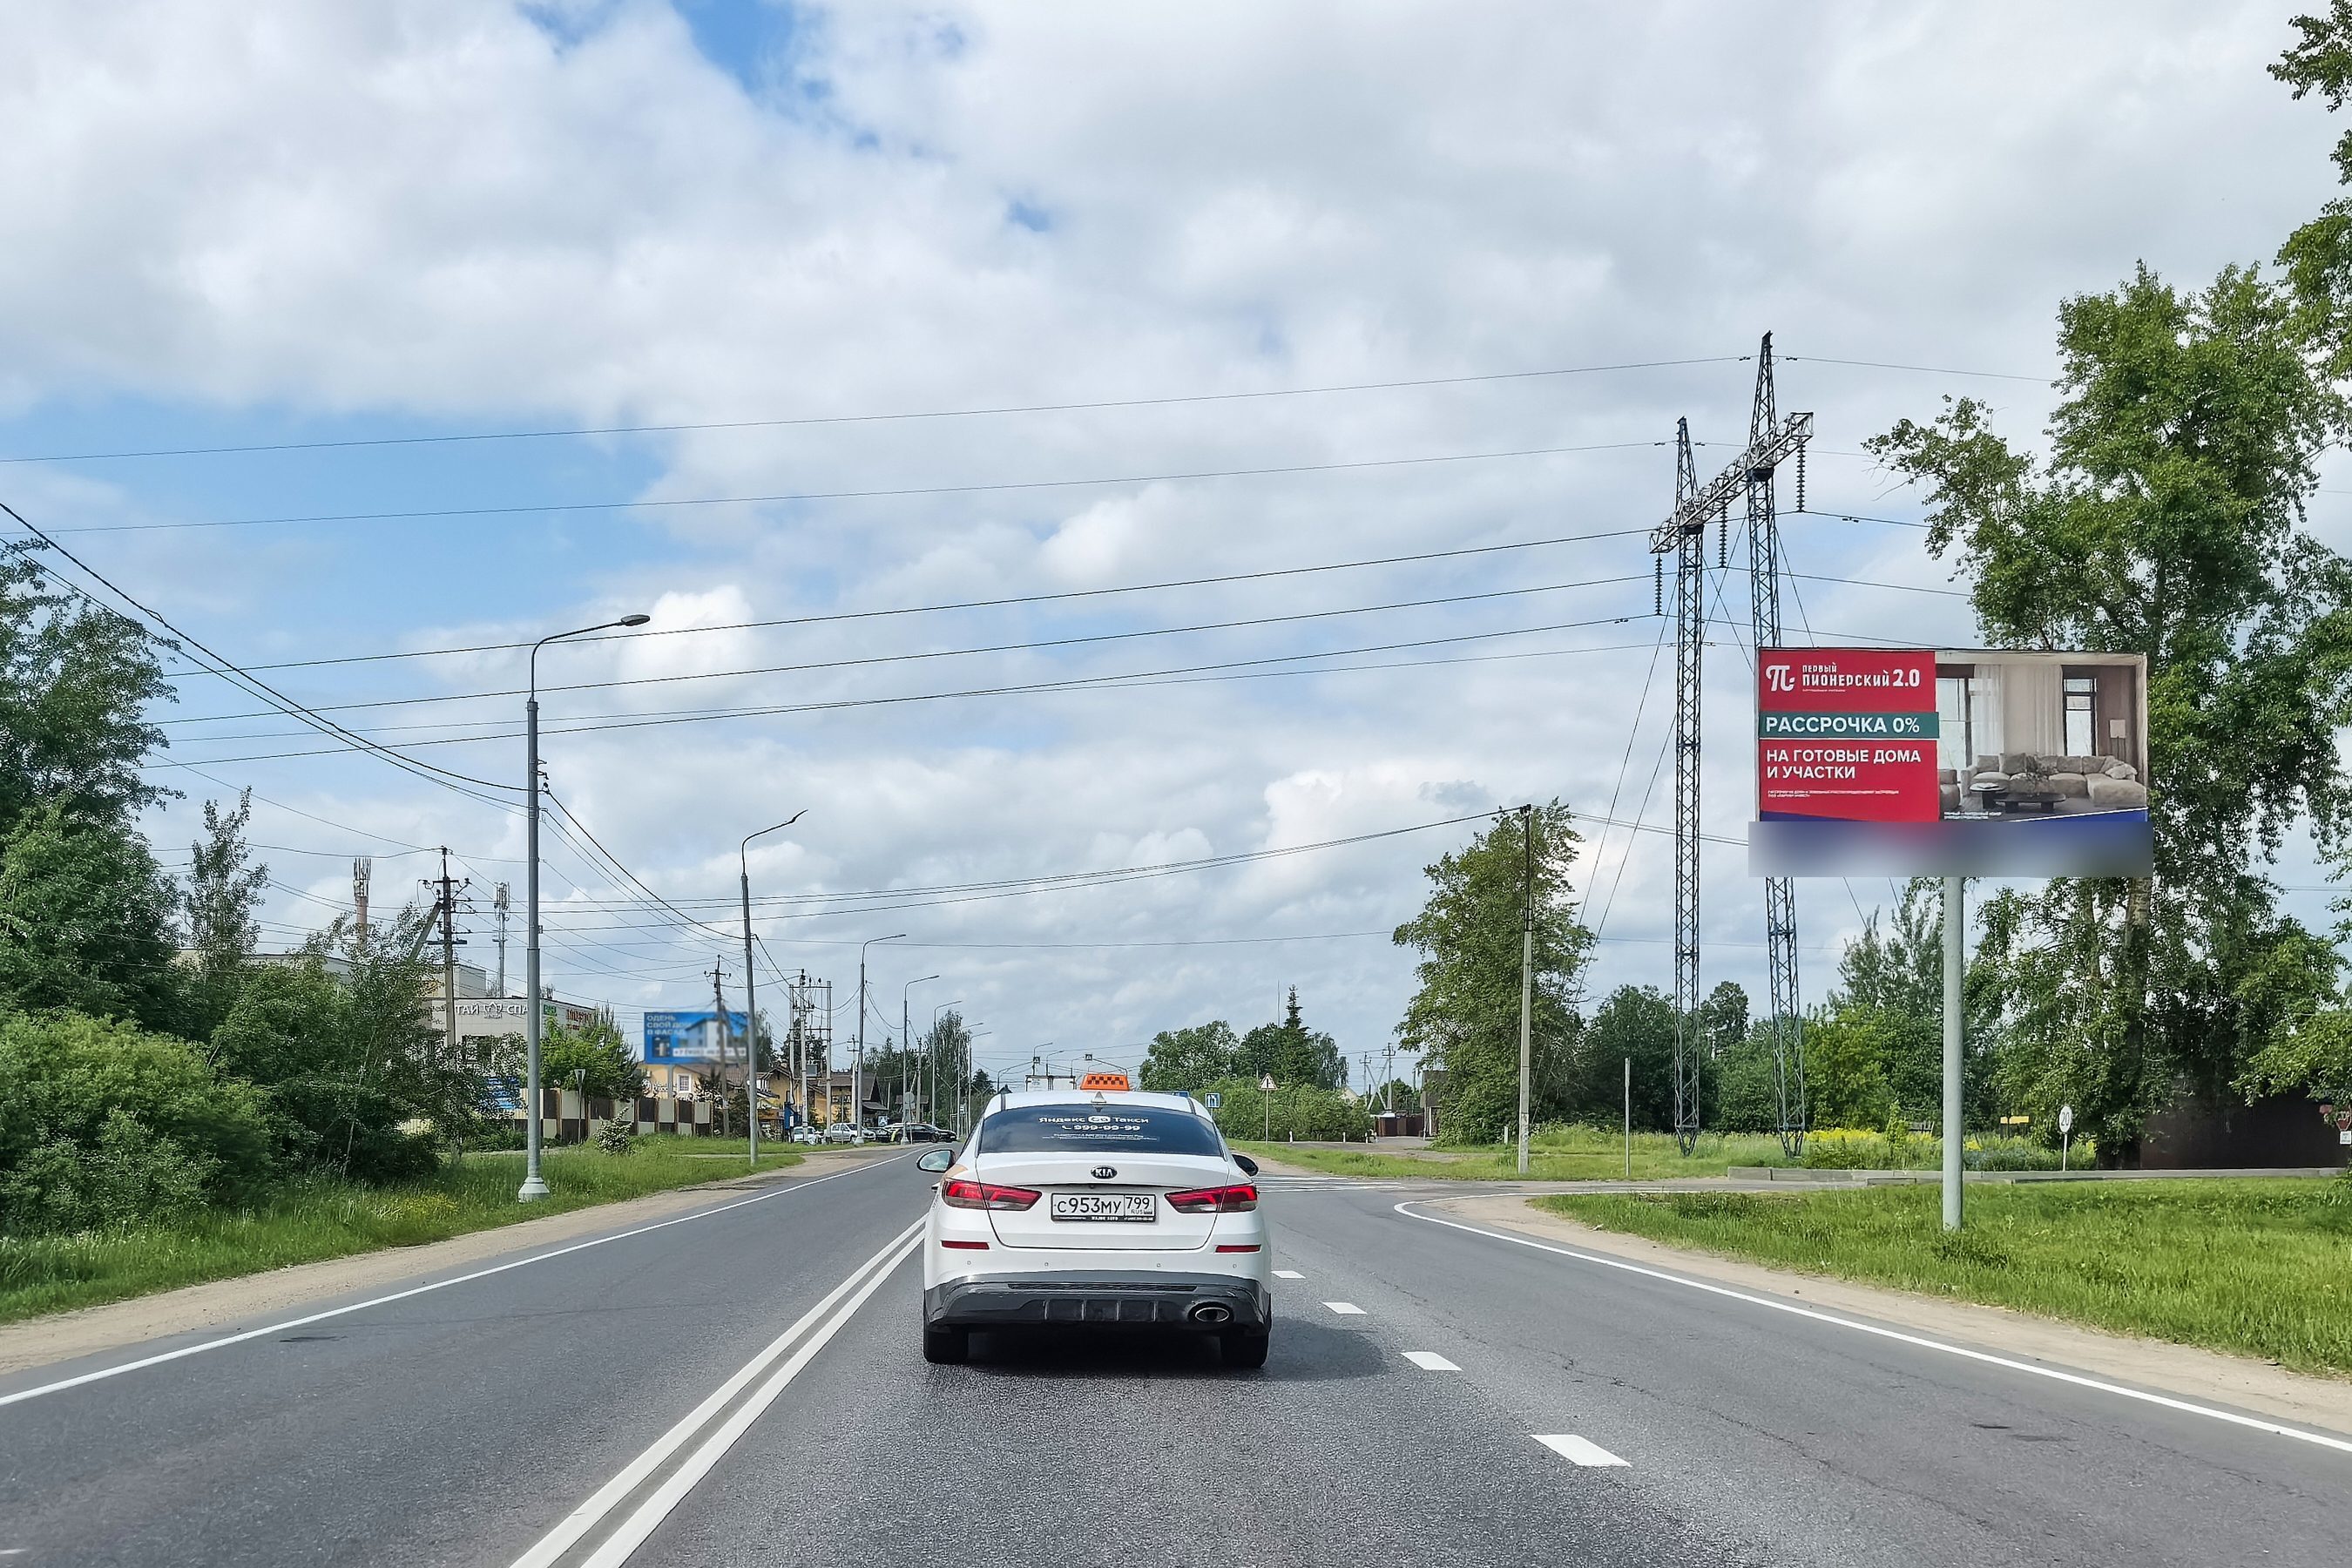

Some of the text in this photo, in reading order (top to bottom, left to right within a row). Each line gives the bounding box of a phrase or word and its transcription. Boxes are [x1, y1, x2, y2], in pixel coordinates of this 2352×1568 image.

[1802, 662, 1837, 673] ПЕРВЫЙ
[1802, 669, 1921, 687] ПИОНЕРСКИЙ 2.0
[1766, 717, 1920, 733] РАССРОЧКА 0%
[1767, 750, 1922, 764] НА ГОТОВЫЕ ДОМА
[1767, 766, 1855, 779] И УЧАСТКИ
[2061, 1112, 2071, 1125] 20
[1095, 1168, 1113, 1177] KIA
[1057, 1196, 1150, 1214] С953МУ 799
